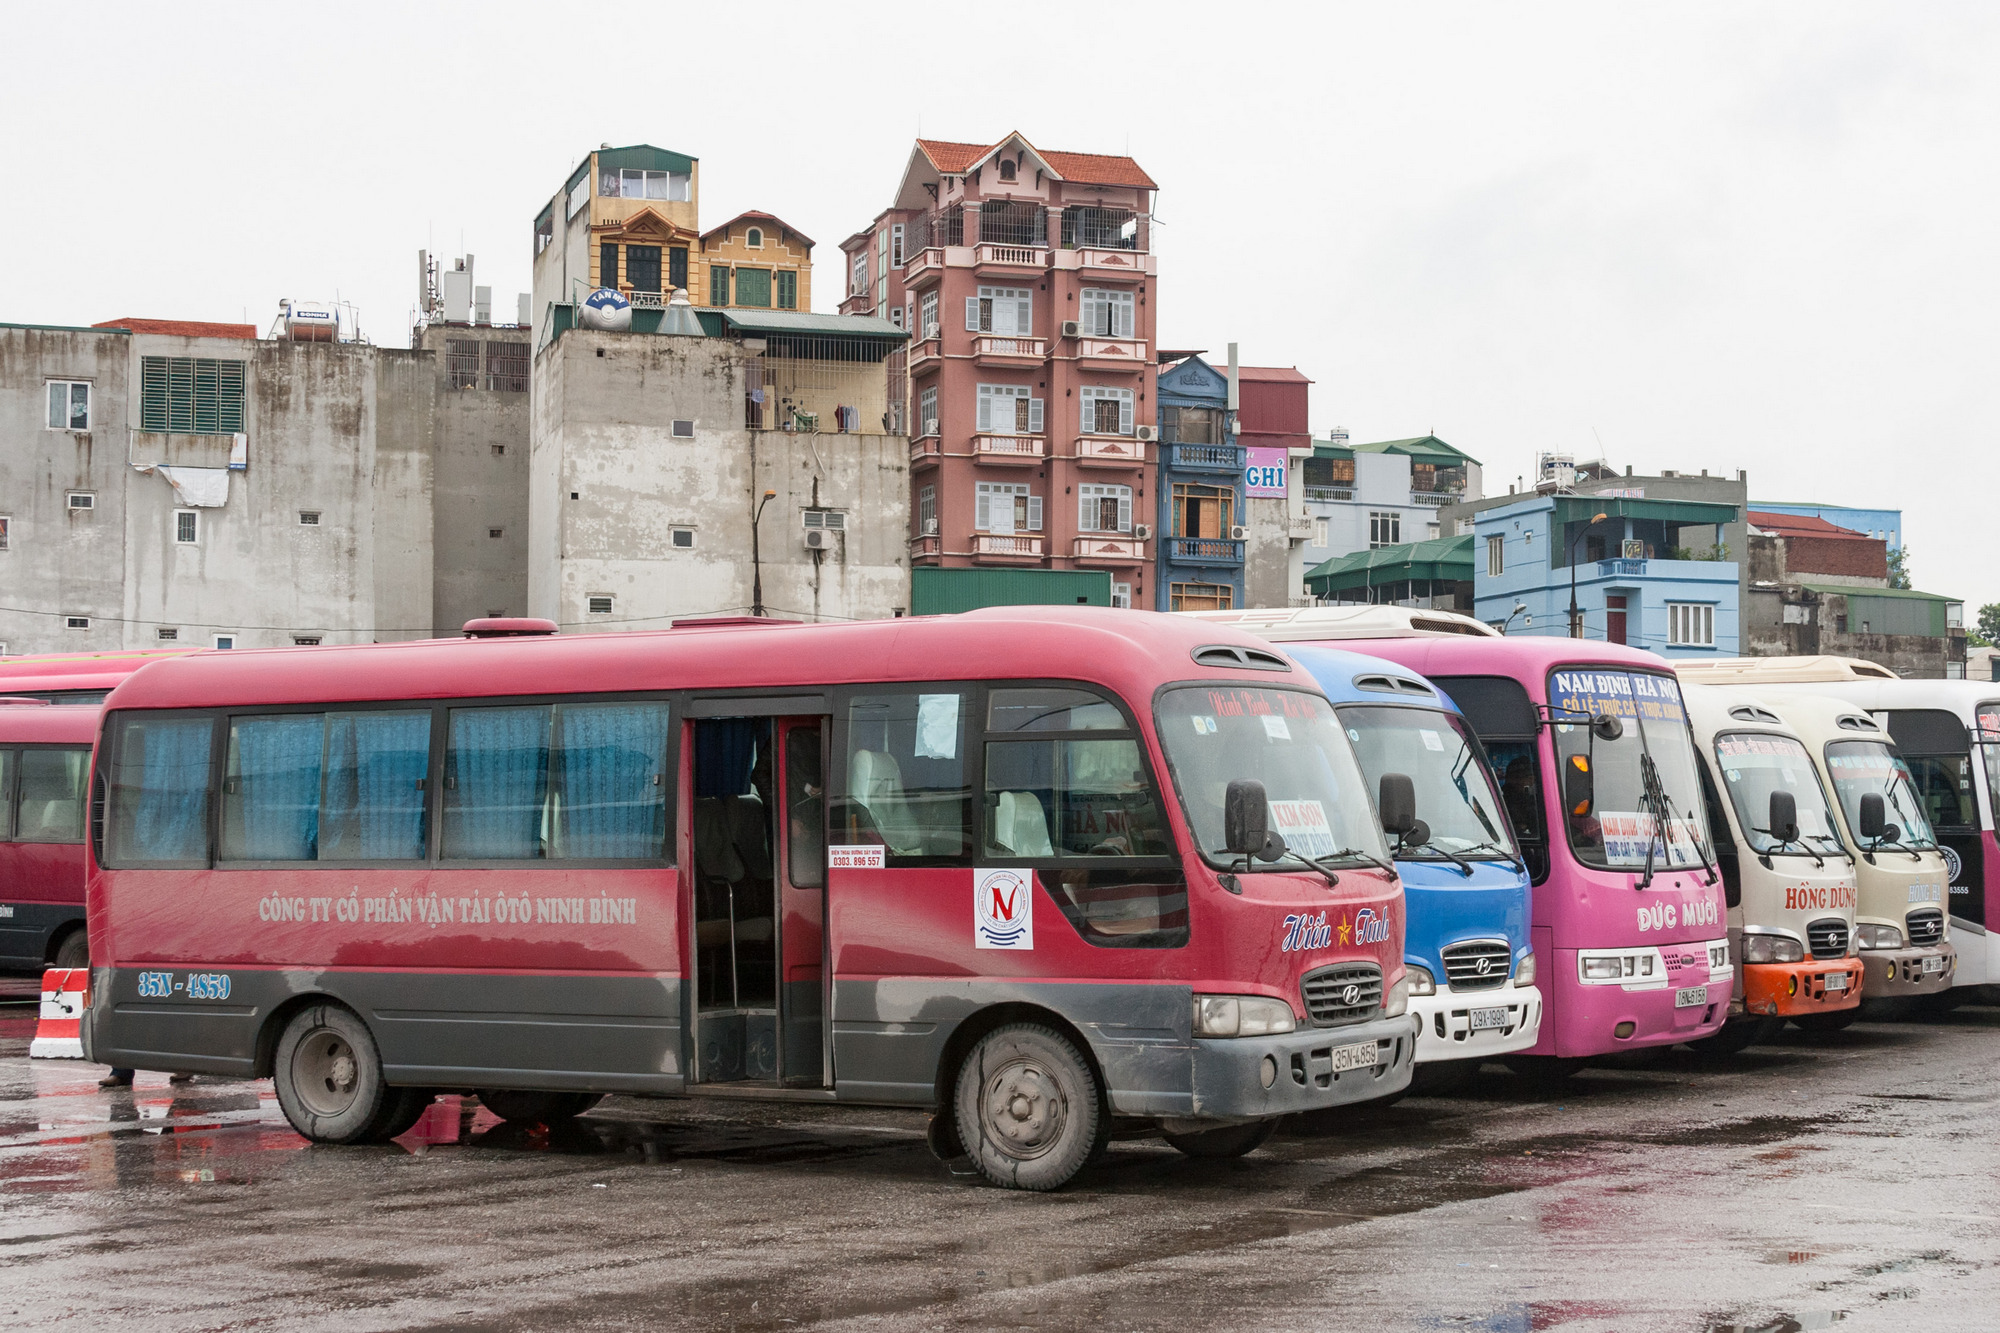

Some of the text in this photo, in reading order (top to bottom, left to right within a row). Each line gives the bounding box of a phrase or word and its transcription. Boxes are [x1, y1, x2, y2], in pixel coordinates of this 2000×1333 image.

[1246, 458, 1285, 488] GHỈ
[1555, 673, 1597, 694] NAM
[1596, 675, 1633, 698] ĐỊNH
[1634, 675, 1658, 697] HÀ
[1273, 804, 1301, 828] KIM
[1601, 817, 1621, 836] NAM
[833, 856, 880, 866] 0303. 896 557
[259, 885, 637, 929] CÔNG TY CỔ PHẦN VẬN TẢI ÔTÔ NINH BÌNH
[1784, 880, 1856, 910] HỒNG DŨNG
[1355, 905, 1390, 946] Tình
[1637, 899, 1677, 932] ĐỨC
[1335, 1044, 1376, 1069] 35N-4859
